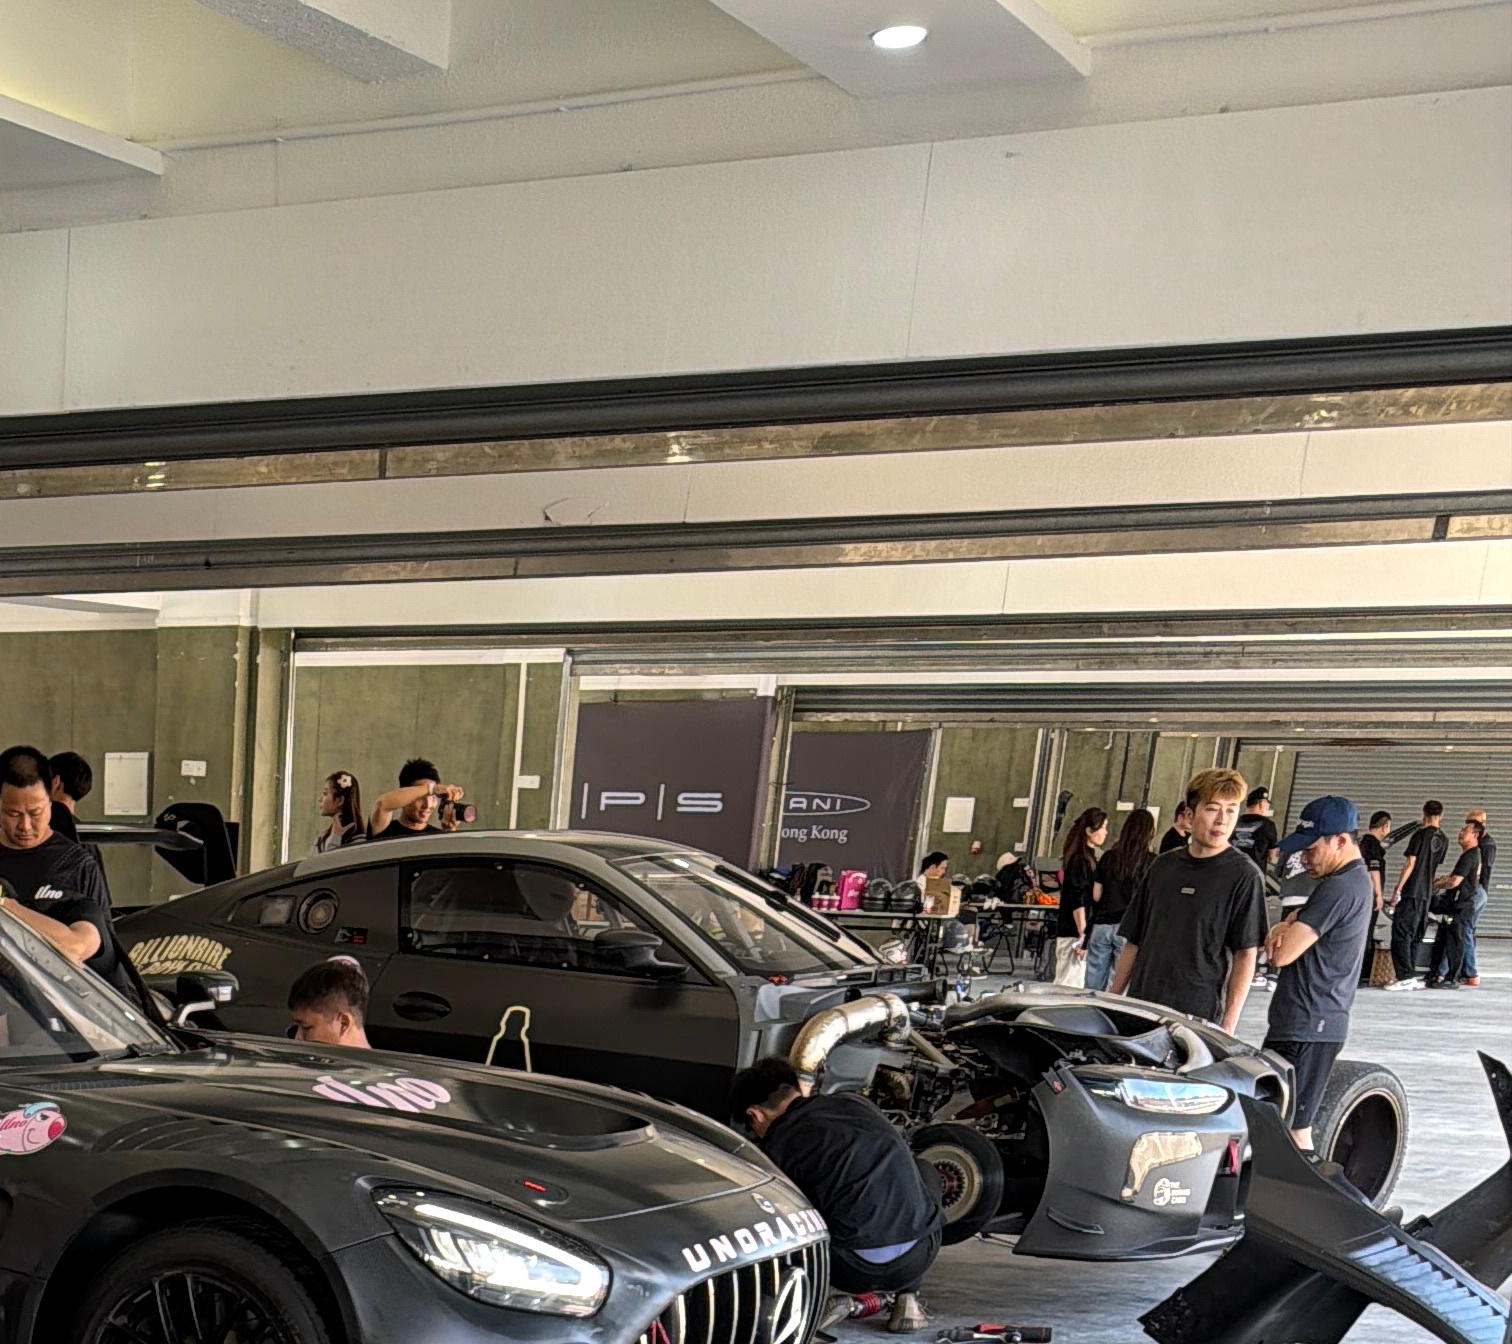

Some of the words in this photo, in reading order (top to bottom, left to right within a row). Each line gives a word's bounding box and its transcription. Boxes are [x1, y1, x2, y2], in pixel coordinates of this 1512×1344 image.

[787, 797, 842, 811] ANI
[781, 827, 808, 843] ong
[810, 825, 849, 843] Kong
[128, 934, 232, 971] BILLIONAIRE
[681, 1207, 829, 1273] UNORACIN
